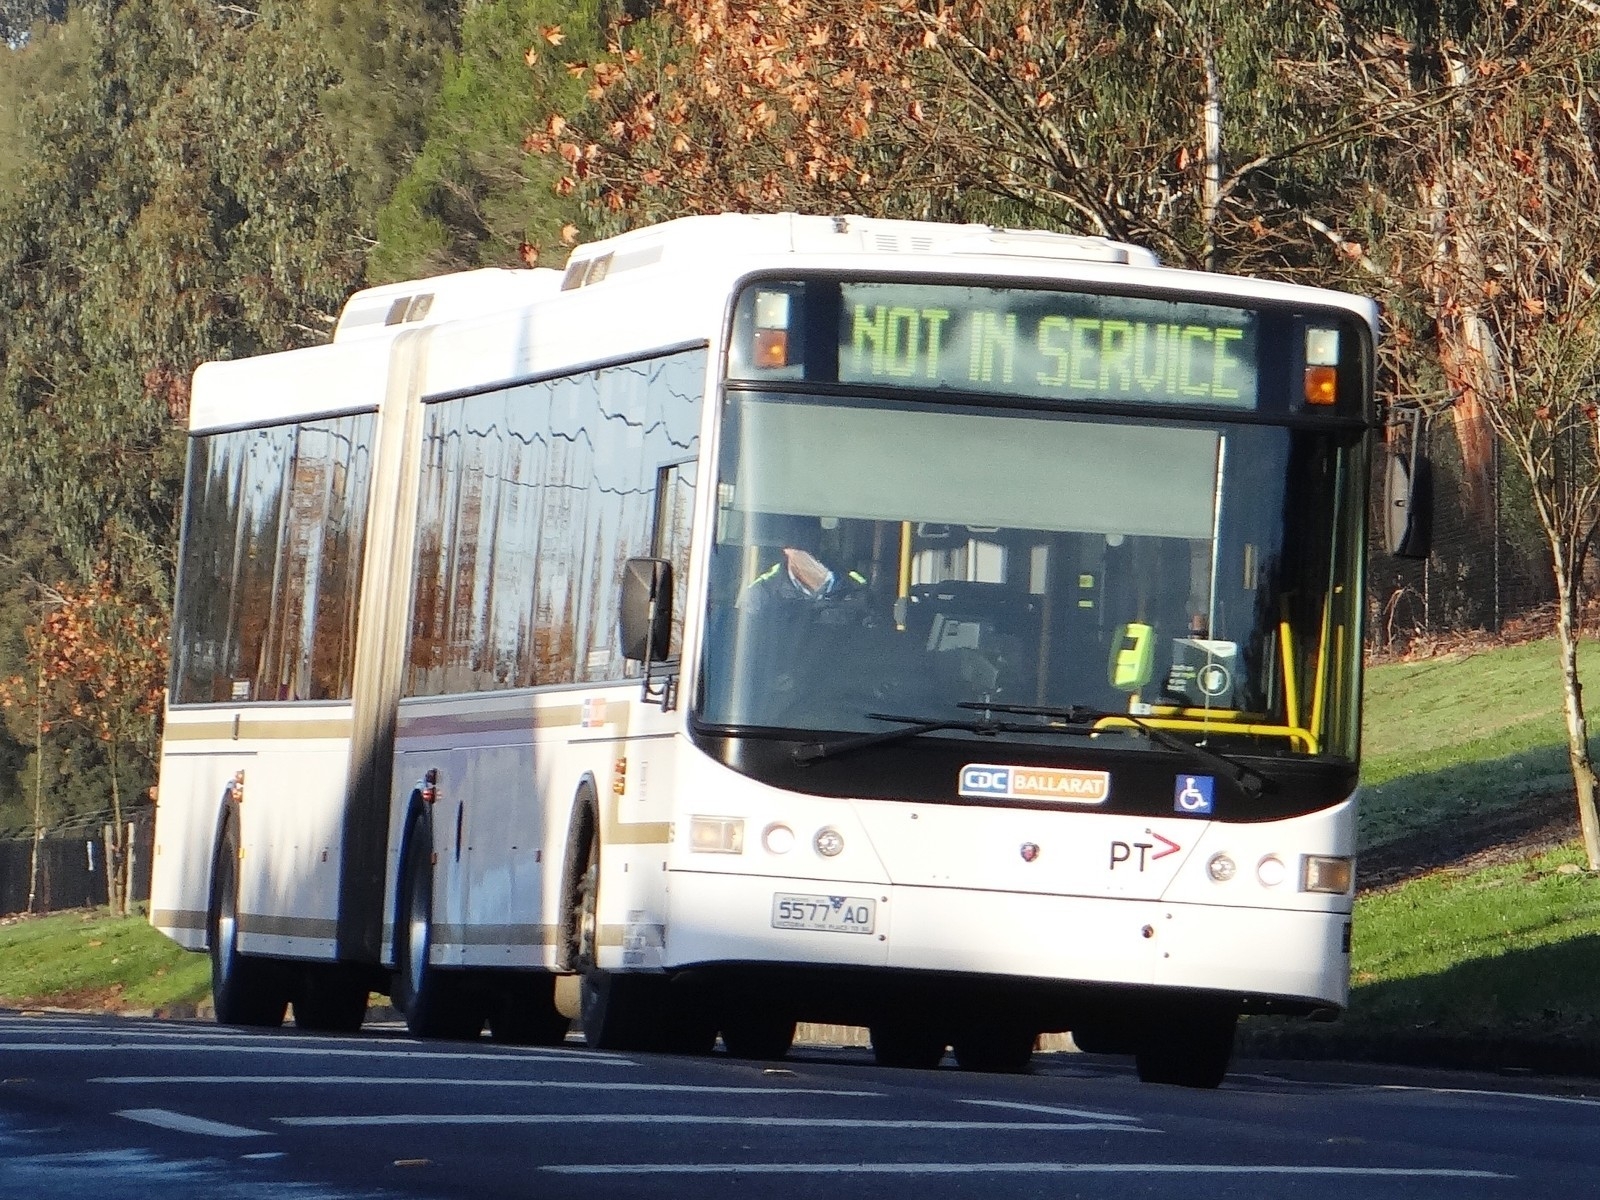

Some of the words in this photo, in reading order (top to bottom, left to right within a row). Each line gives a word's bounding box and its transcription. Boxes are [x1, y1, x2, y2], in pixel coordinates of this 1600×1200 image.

[852, 304, 949, 379] NOT
[969, 311, 1017, 383] IN
[1036, 315, 1243, 398] SERVICE
[964, 771, 1007, 789] CDC
[1014, 774, 1104, 794] BALLARAT
[779, 901, 830, 922] 5577
